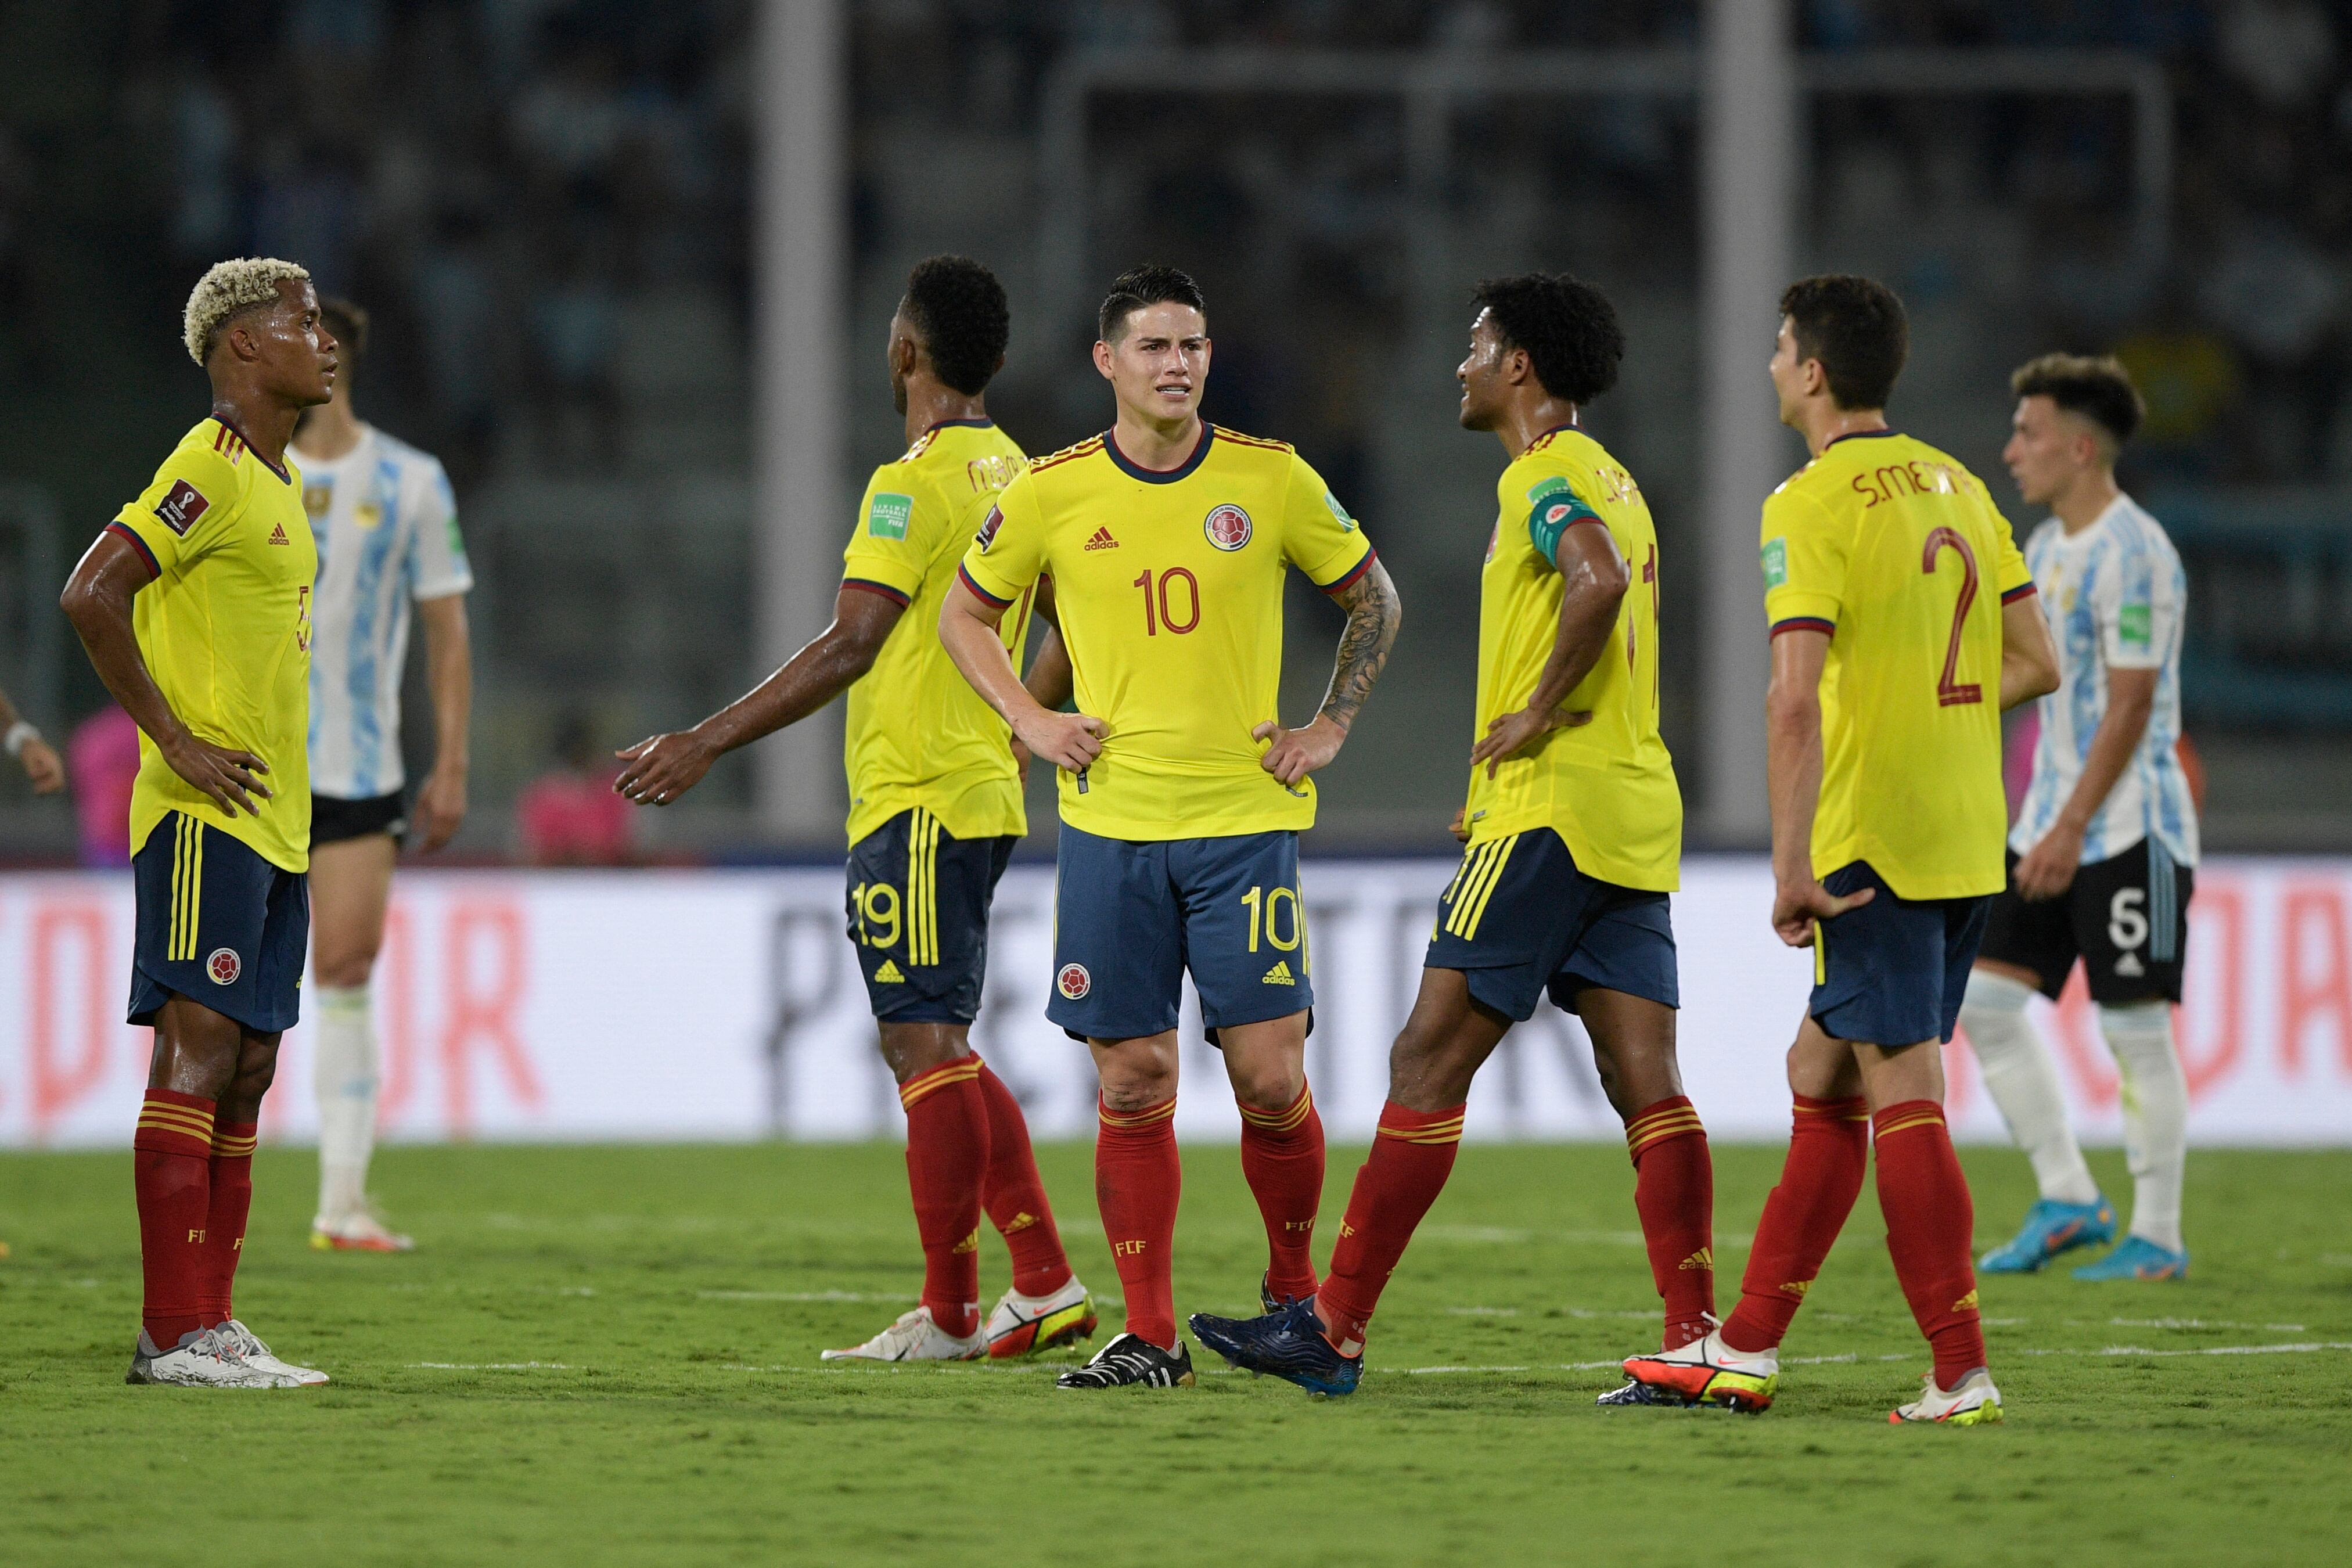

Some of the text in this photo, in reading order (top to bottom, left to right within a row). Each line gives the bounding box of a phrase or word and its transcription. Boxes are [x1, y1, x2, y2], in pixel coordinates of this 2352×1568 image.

[1084, 541, 1119, 551] adidas
[1134, 567, 1200, 636] 10
[1922, 526, 1981, 707] 2
[852, 882, 901, 948] 19
[1241, 886, 1300, 952] 10
[2108, 887, 2148, 950] 6
[1262, 975, 1295, 986] adidas
[1115, 1240, 1146, 1257] FCF
